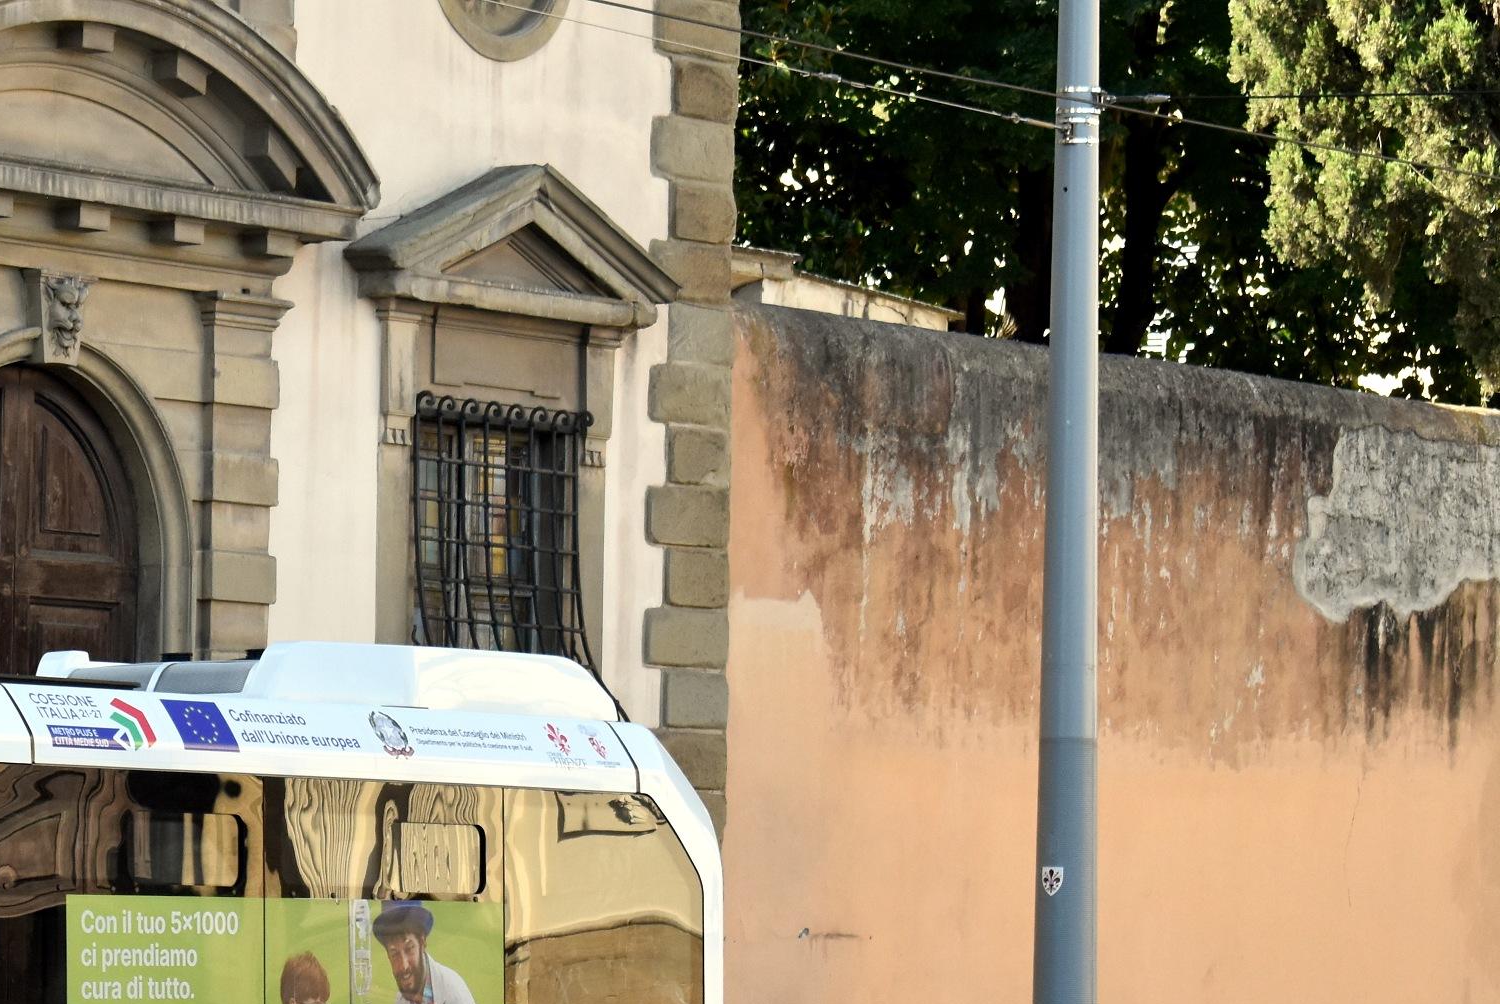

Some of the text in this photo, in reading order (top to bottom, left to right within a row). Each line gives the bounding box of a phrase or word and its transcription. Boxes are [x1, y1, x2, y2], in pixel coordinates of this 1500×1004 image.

[29, 692, 97, 707] COESIONE
[36, 706, 102, 720] ITALIA 21-27
[228, 709, 306, 726] Cofinanziato
[50, 727, 99, 737] METRO PLUS E
[241, 729, 361, 750] dall'Unione europea
[409, 725, 527, 740] Presidenza del Consiglio dei Ministri
[73, 737, 95, 746] MEDIE
[94, 738, 109, 747] SUD
[81, 910, 117, 934] Con
[122, 910, 132, 934] il
[136, 912, 165, 934] tuo
[81, 942, 197, 972] ci prendiamo
[81, 975, 195, 1000] cura di tutto.
